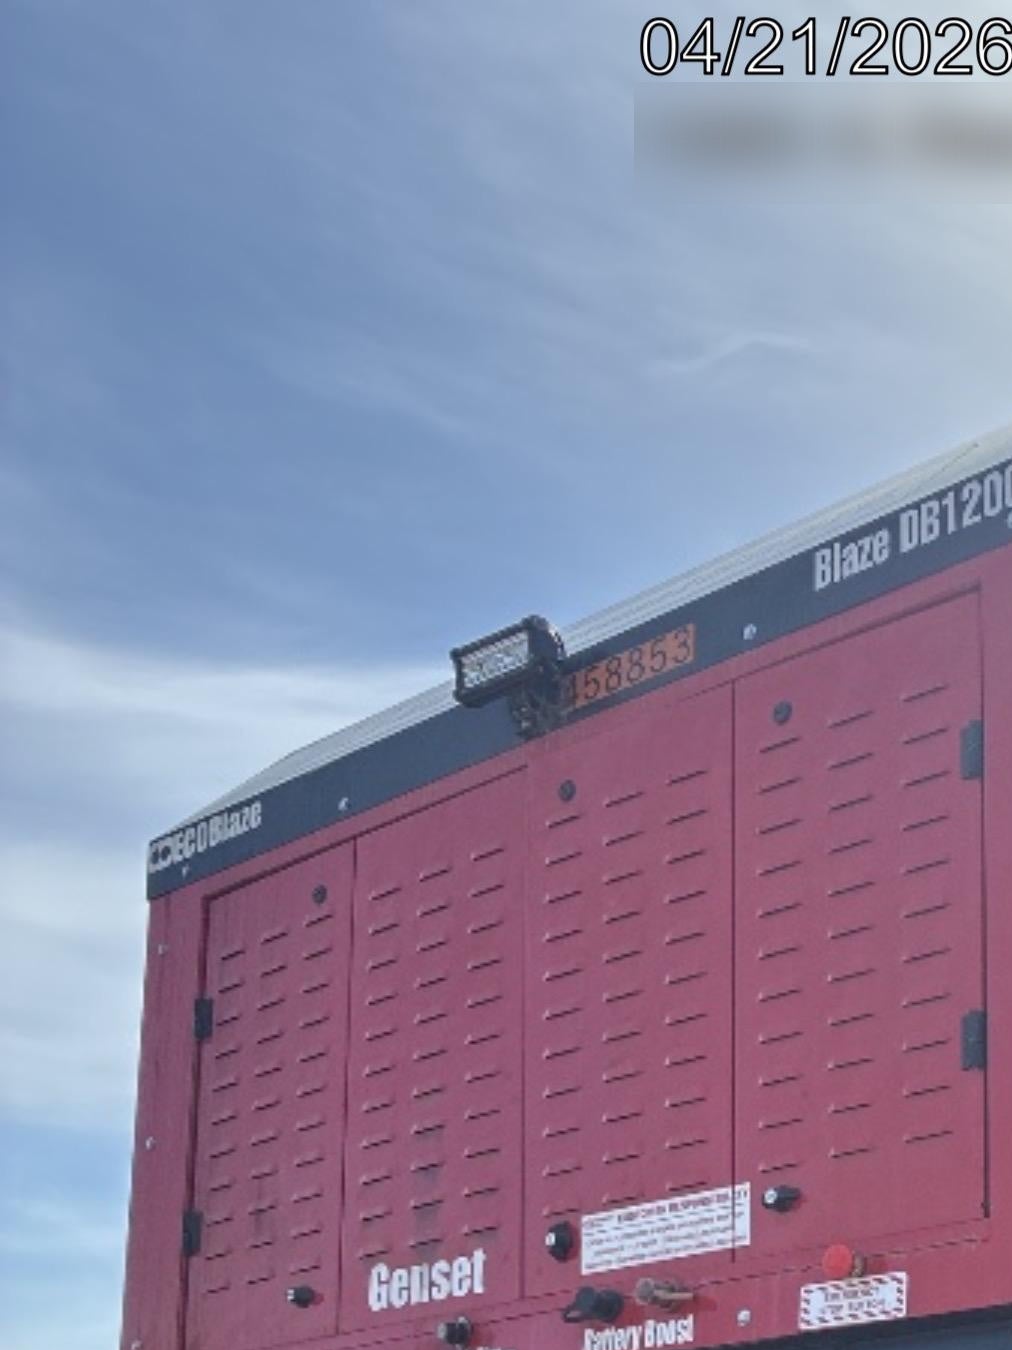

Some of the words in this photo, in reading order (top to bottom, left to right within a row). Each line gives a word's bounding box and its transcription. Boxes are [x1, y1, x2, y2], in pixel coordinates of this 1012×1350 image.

[813, 528, 892, 592] Blaze
[368, 1248, 487, 1312] Genset
[643, 1313, 694, 1349] Boost
